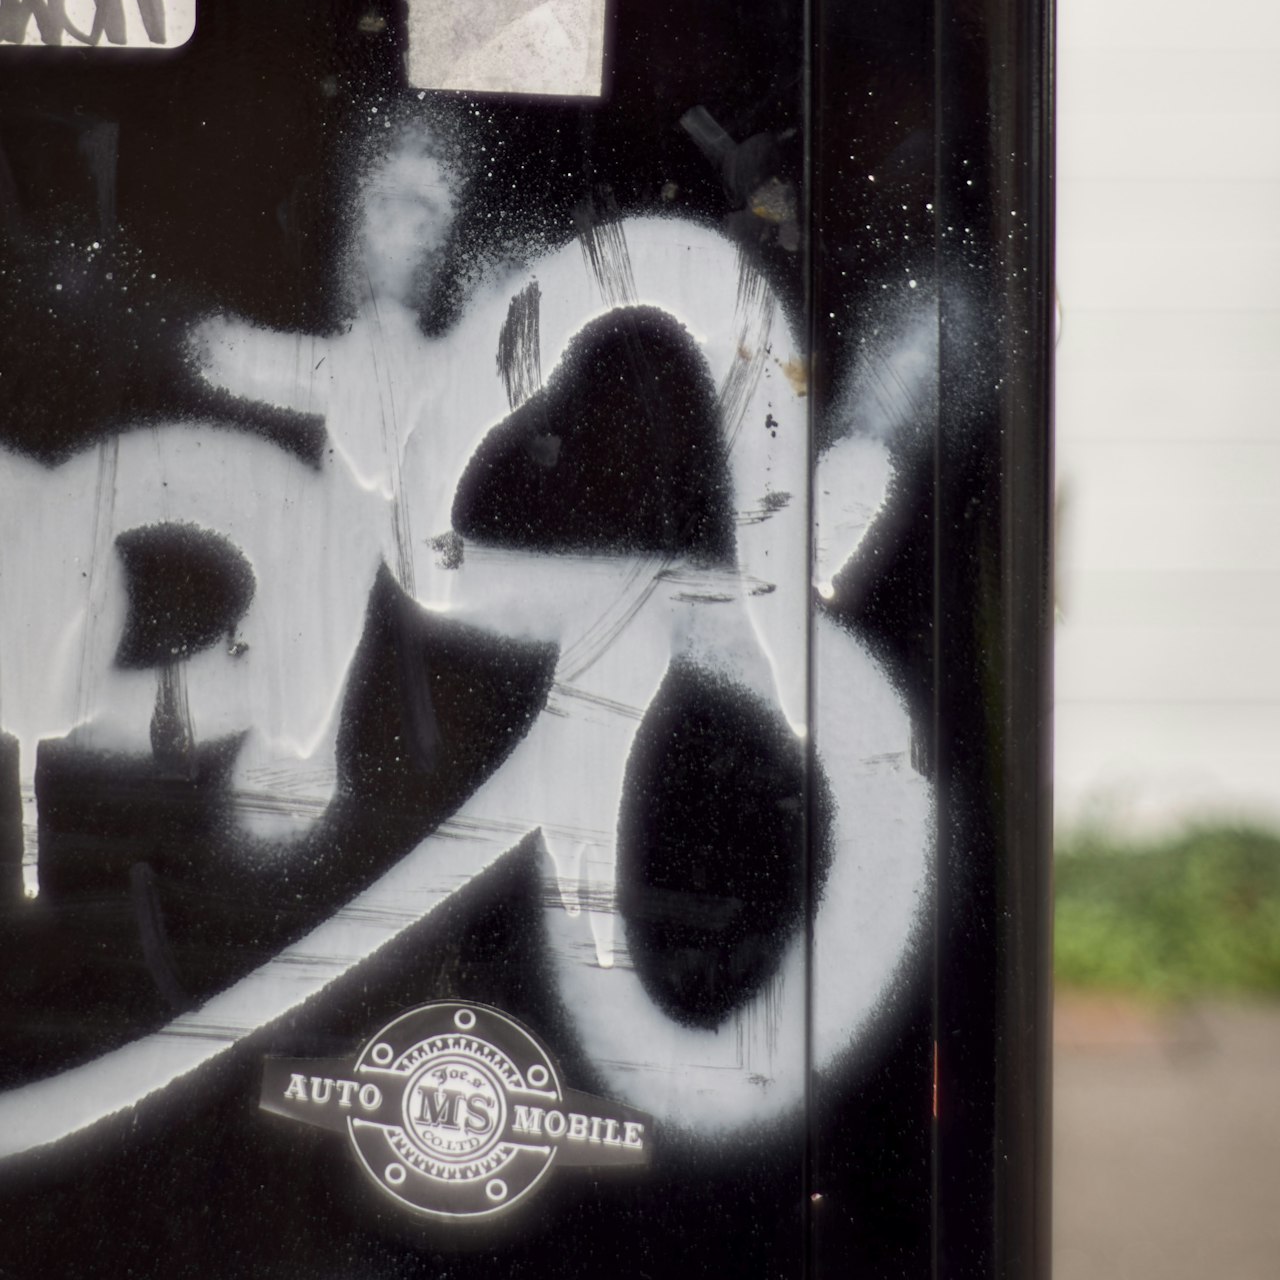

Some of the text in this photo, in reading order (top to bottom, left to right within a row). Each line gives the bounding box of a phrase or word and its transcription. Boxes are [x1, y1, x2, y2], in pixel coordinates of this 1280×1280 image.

[283, 1073, 645, 1149] AUTO MS MOBILE
